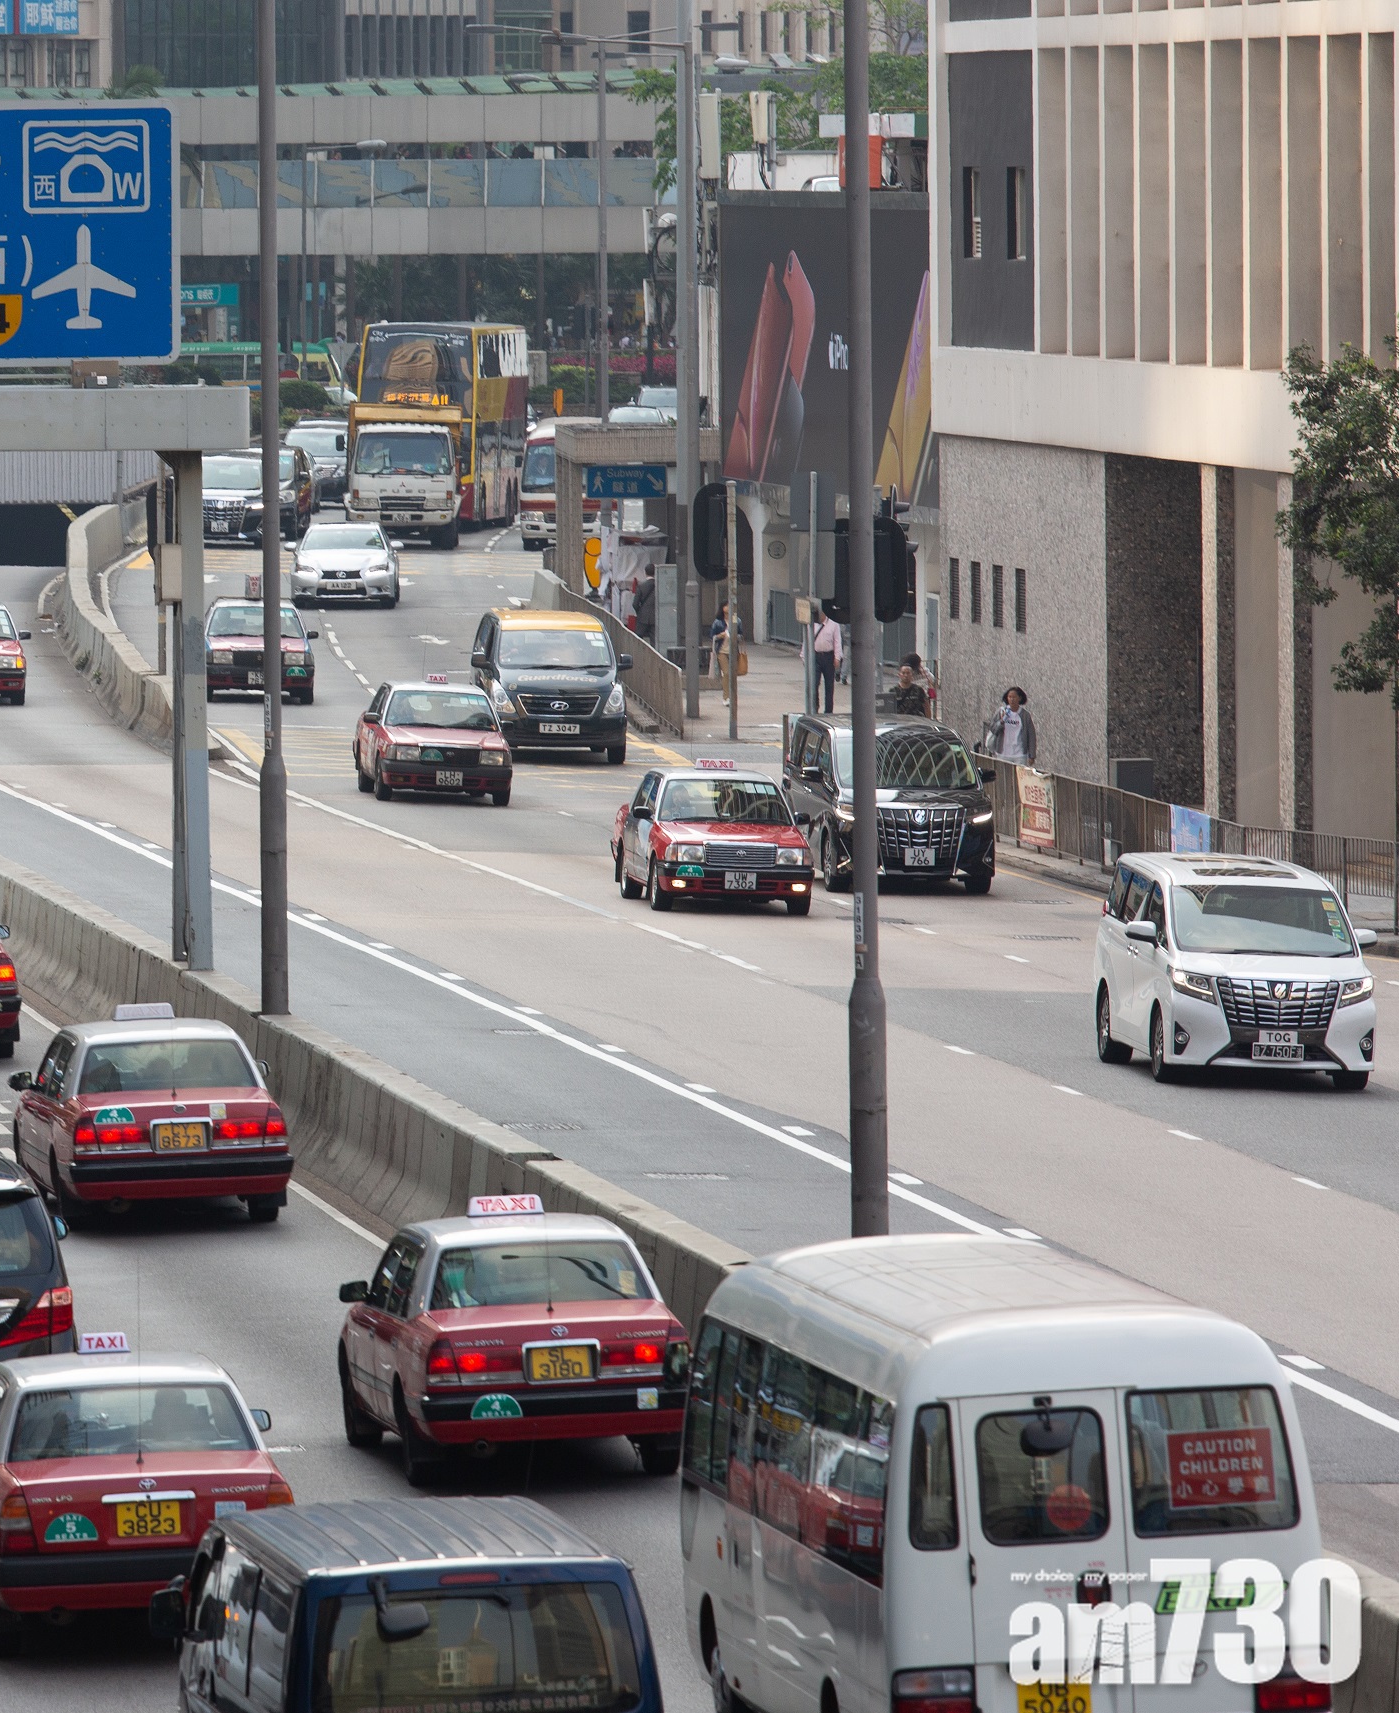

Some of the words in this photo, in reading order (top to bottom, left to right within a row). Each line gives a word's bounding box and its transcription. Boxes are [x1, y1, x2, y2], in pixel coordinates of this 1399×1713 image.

[33, 175, 56, 201] 西
[113, 172, 141, 200] W
[607, 469, 645, 480] Subway
[612, 481, 638, 493] 隧道
[429, 674, 448, 682] TAXI
[518, 673, 599, 684] Guardforce
[542, 724, 554, 732] TZ
[556, 725, 578, 733] 3047
[700, 759, 735, 769] TAXI
[439, 778, 461, 786] 9602
[913, 849, 926, 857] UY
[911, 857, 930, 865] 766
[733, 872, 748, 881] UW
[727, 880, 754, 890] 7302
[119, 1006, 171, 1019] TAXI
[1266, 1032, 1291, 1043] TOG
[161, 1134, 203, 1148] 8673
[477, 1196, 536, 1213] TAXI
[84, 1335, 126, 1351] TAXI
[548, 1348, 572, 1362] SL
[538, 1362, 584, 1378] 3180
[481, 1409, 513, 1419] SEATS
[1183, 1436, 1257, 1457] CAUTION
[1178, 1457, 1264, 1476] CHILDREN
[230, 1484, 268, 1494] COMFORT
[135, 1501, 162, 1520] CU
[60, 1513, 82, 1523] TAXI
[66, 1522, 77, 1535] 5
[123, 1519, 176, 1536] 3823
[55, 1531, 89, 1541] SEATS
[1038, 1677, 1070, 1699] UB
[1022, 1696, 1087, 1713] 5040
